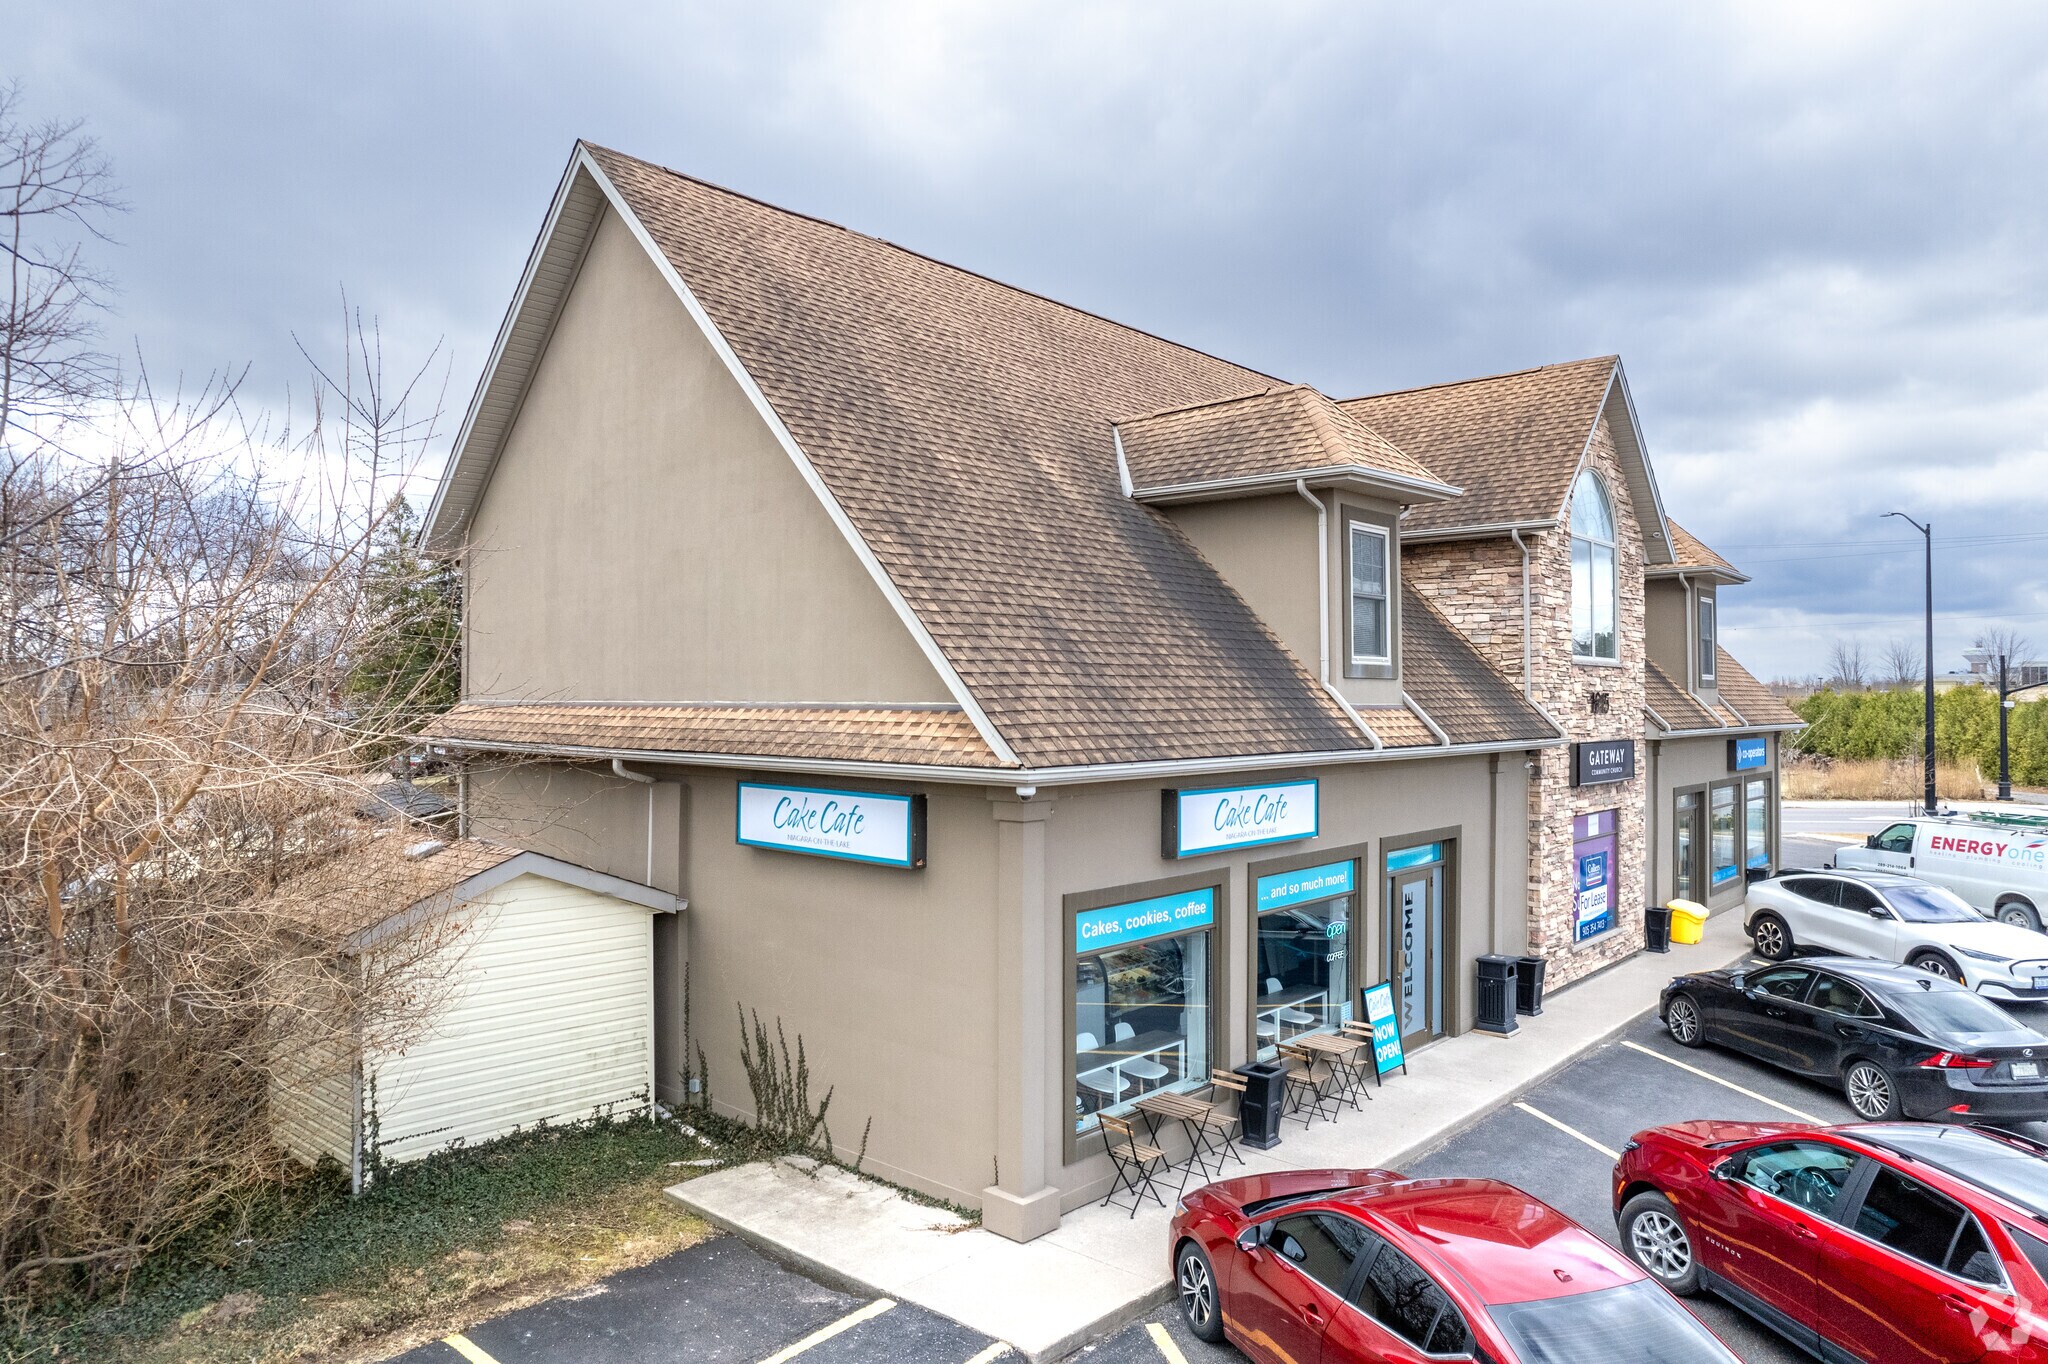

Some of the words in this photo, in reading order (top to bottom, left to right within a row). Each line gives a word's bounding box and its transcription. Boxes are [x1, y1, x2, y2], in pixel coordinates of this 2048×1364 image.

[1589, 748, 1625, 766] GATEWAY
[1591, 768, 1610, 776] COMMUNITY
[773, 796, 817, 833] Cake
[820, 800, 865, 836] Cafe
[1213, 795, 1251, 831] Cake
[1253, 793, 1288, 825] Cafe
[1929, 850, 1957, 858] heating
[1965, 855, 2001, 864] plumbing
[2011, 860, 2043, 870] cooling
[1270, 883, 1288, 899] and
[1288, 882, 1301, 895] so
[1300, 875, 1324, 893] much
[1325, 871, 1348, 887] more!
[1580, 893, 1591, 911] For
[1590, 891, 1606, 907] Lease
[1081, 916, 1123, 939] Cakes,
[1125, 908, 1173, 931] cookies,
[1174, 900, 1207, 919] coffee
[1404, 891, 1414, 1030] WELCOME
[1374, 1021, 1395, 1042] NOW
[1376, 1039, 1401, 1063] OPEN!
[1705, 1236, 1742, 1259] EQUINOX
